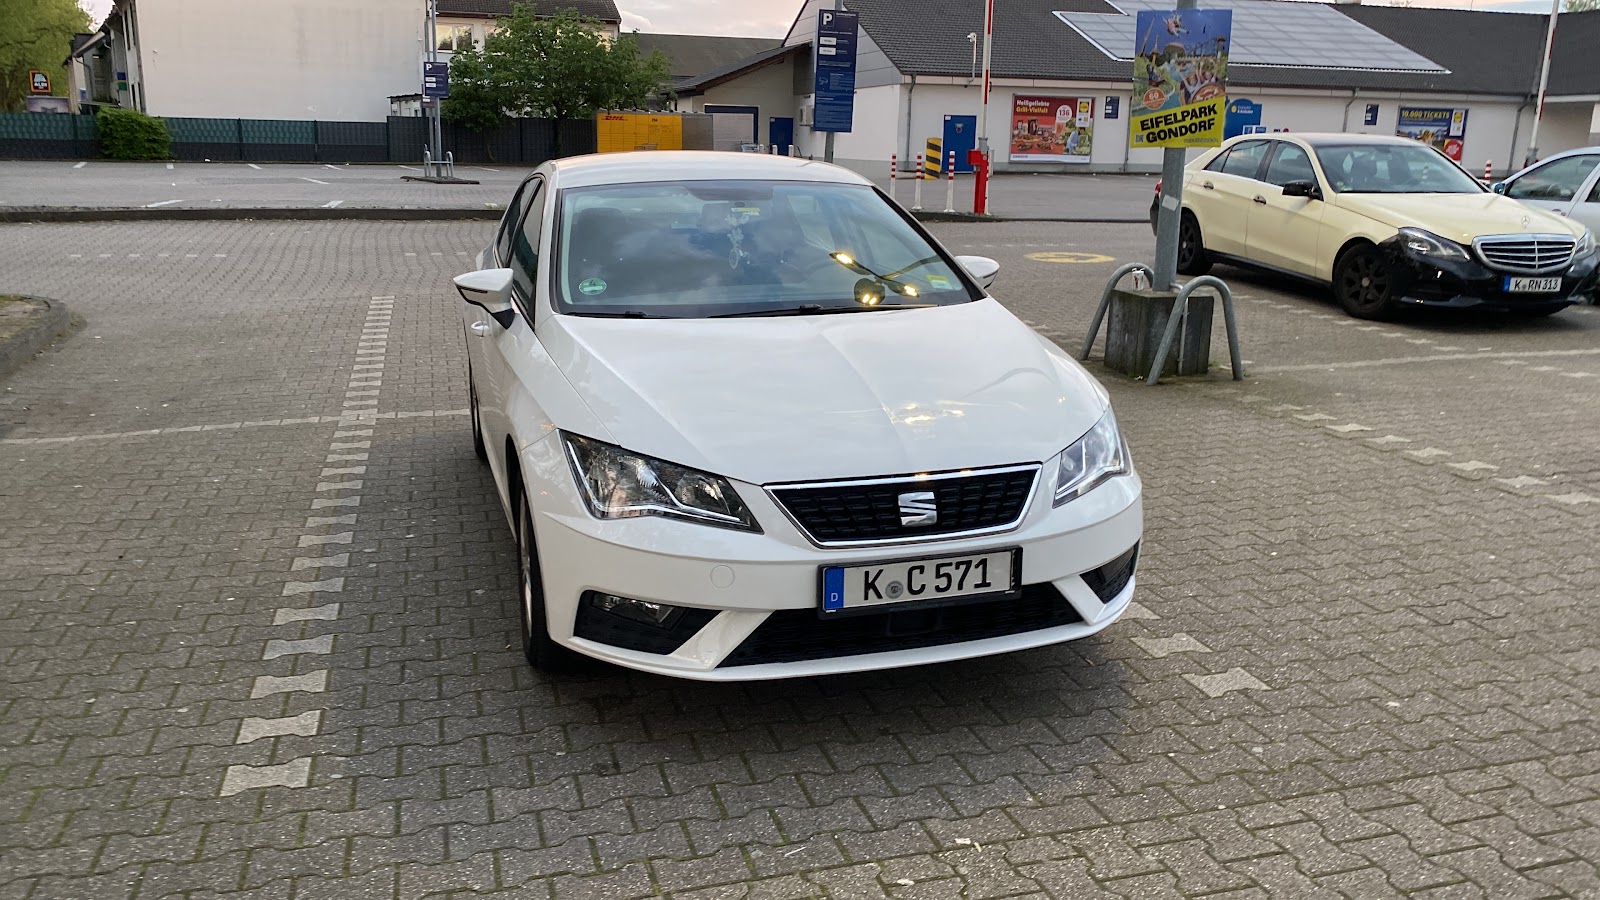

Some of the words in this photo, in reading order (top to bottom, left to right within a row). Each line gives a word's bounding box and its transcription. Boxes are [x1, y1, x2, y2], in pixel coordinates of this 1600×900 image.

[823, 13, 833, 25] P
[426, 63, 432, 71] P
[1148, 91, 1159, 100] 60
[1016, 99, 1050, 108] Heißgeliebte
[1016, 106, 1049, 114] Grill-Vielfalt
[1059, 109, 1070, 117] 136
[1402, 110, 1422, 118] 10.000
[1424, 111, 1450, 119] TICKETS
[1140, 103, 1217, 131] EIFELPARK
[1146, 118, 1216, 143] GONDORF
[1514, 279, 1522, 290] K
[1528, 279, 1541, 290] RN
[1542, 279, 1558, 290] 313
[863, 569, 884, 601] K
[907, 565, 926, 596] C
[934, 557, 992, 593] 571
[830, 592, 838, 602] D
